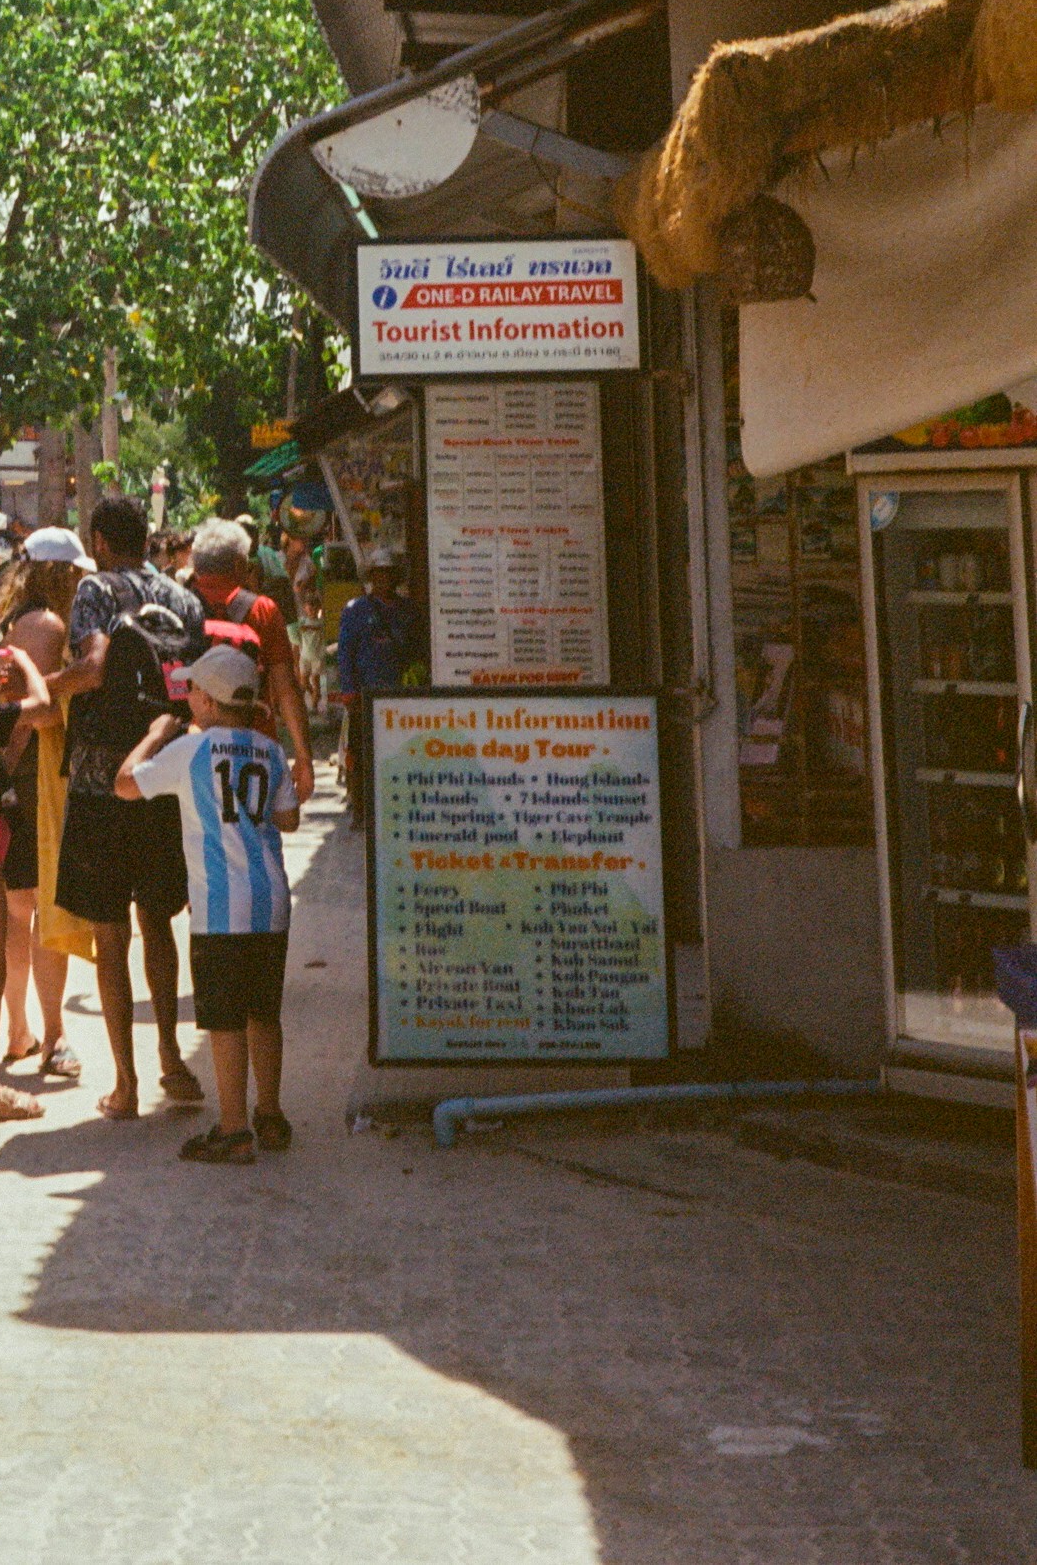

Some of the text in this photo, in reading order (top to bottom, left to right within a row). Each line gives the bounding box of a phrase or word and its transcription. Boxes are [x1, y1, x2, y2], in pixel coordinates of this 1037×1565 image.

[416, 284, 616, 305] ONE-D RAILAY TRAVEL
[372, 316, 625, 343] Tourist Information
[380, 707, 651, 730] Tourist Information
[211, 742, 271, 759] ARGENTINA
[424, 738, 596, 764] One day Tour
[407, 771, 525, 786] Phi Phi Islands
[547, 772, 650, 788] Hong Islands
[214, 759, 269, 826] 10
[421, 790, 479, 805] Islands
[531, 790, 589, 805] Islands
[592, 792, 647, 805] Sunset
[408, 809, 496, 827] Hot Spring
[513, 810, 653, 827] Tiger Cave Temple
[408, 829, 519, 846] Emerald pool
[551, 829, 625, 845] Elephant
[410, 849, 495, 871] Ticket
[512, 850, 633, 871] Transfer
